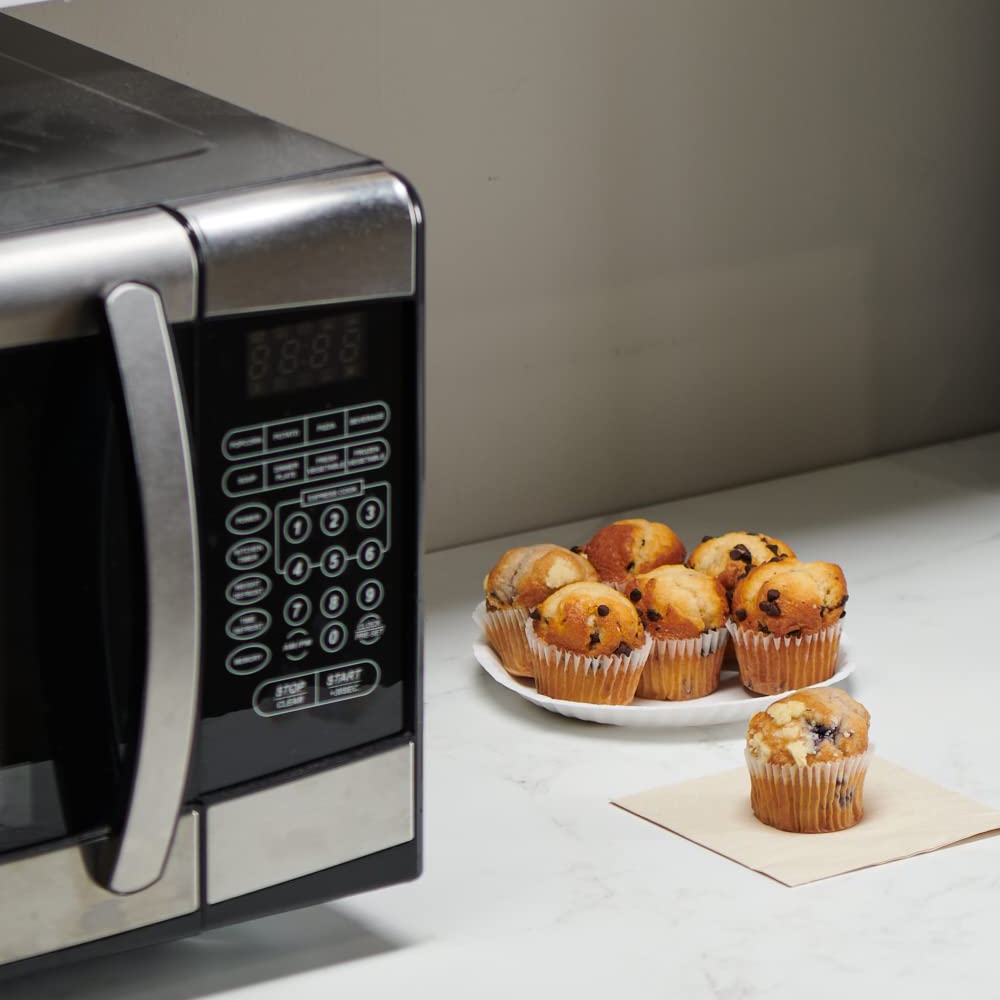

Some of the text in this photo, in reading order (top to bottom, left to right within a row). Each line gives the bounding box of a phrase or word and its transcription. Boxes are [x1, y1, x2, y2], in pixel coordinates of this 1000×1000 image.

[329, 511, 340, 528] 2
[365, 504, 376, 521] 3
[293, 519, 303, 536] 1
[328, 552, 340, 570] 5
[365, 546, 376, 562] 6
[292, 561, 303, 577] 4
[328, 594, 340, 611] 8
[365, 587, 376, 603] 9
[292, 602, 303, 619] 7
[328, 628, 340, 646] 0
[326, 668, 363, 687] START
[275, 680, 307, 698] STOP
